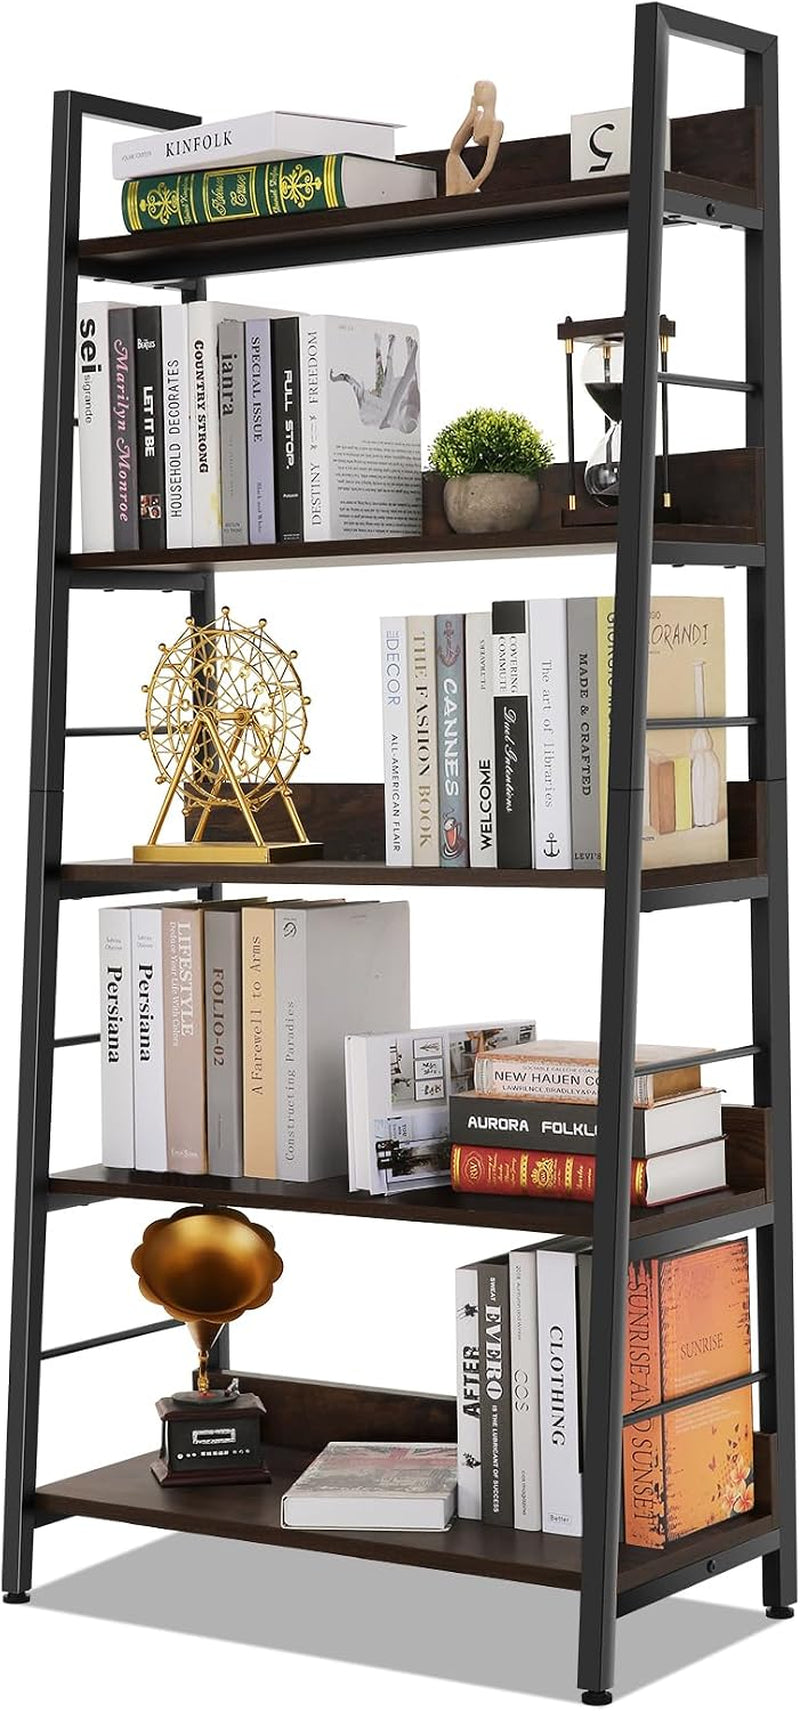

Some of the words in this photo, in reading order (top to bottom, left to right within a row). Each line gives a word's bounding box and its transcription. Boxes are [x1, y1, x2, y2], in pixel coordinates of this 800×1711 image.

[165, 130, 233, 158] KINFOLK
[589, 123, 615, 173] 5
[80, 318, 102, 373] sei
[251, 336, 262, 398] SPECIAL
[307, 331, 319, 404] FREEDOM
[112, 339, 129, 431] Marilyn
[143, 386, 154, 415] LET
[167, 360, 181, 435] DECORATES
[194, 340, 206, 411] COUNTRY
[283, 370, 293, 413] FULL
[144, 418, 155, 433] IT
[144, 435, 155, 457] BE
[198, 413, 209, 474] STRONG
[252, 401, 263, 443] ISSUE
[285, 419, 295, 470] STOP.
[115, 437, 131, 522] Monroe
[169, 442, 182, 519] HOUSEHOLD
[310, 462, 322, 526] DESTINY
[413, 631, 427, 679] THE
[498, 635, 508, 692] COMMUTE
[509, 635, 519, 694] COVERING
[651, 622, 708, 651] ORANDI
[386, 639, 401, 706] DECOR
[541, 658, 554, 683] The
[578, 653, 590, 700] MADE
[541, 688, 553, 712] art
[542, 717, 555, 736] of
[580, 704, 590, 717] &
[414, 685, 431, 777] FASHION
[442, 677, 460, 797] CANNES
[579, 721, 592, 797] CRAFTED
[390, 733, 401, 818] ALL-AMERICAN
[543, 743, 556, 809] libraries
[418, 784, 433, 848] BOOK
[479, 759, 493, 851] WELCOME
[392, 821, 402, 853] FLAIR
[177, 920, 194, 1037] LIFESTYLE
[249, 936, 263, 973] Arms
[107, 965, 123, 1063] Persiana
[138, 963, 154, 1062] Persiana
[212, 967, 225, 1067] FOLIO-02
[251, 981, 263, 999] to
[250, 1009, 264, 1080] Farewell
[251, 1086, 264, 1096] A
[494, 1071, 528, 1083] NEW
[284, 1069, 297, 1162] Constructing
[467, 1115, 530, 1133] AURORA
[541, 1121, 598, 1138] FOLKL
[489, 1277, 497, 1302] SWEAT
[627, 1280, 652, 1376] SUNRISE
[680, 1332, 724, 1361] SUNRISE
[462, 1346, 481, 1420] AFTER
[492, 1404, 499, 1412] IS
[514, 1368, 529, 1413] COS
[549, 1325, 566, 1446] CLOTHING
[629, 1380, 655, 1433] AND
[492, 1428, 500, 1468] LUBRICANT
[492, 1468, 500, 1479] OF
[631, 1437, 657, 1525] SUNSET
